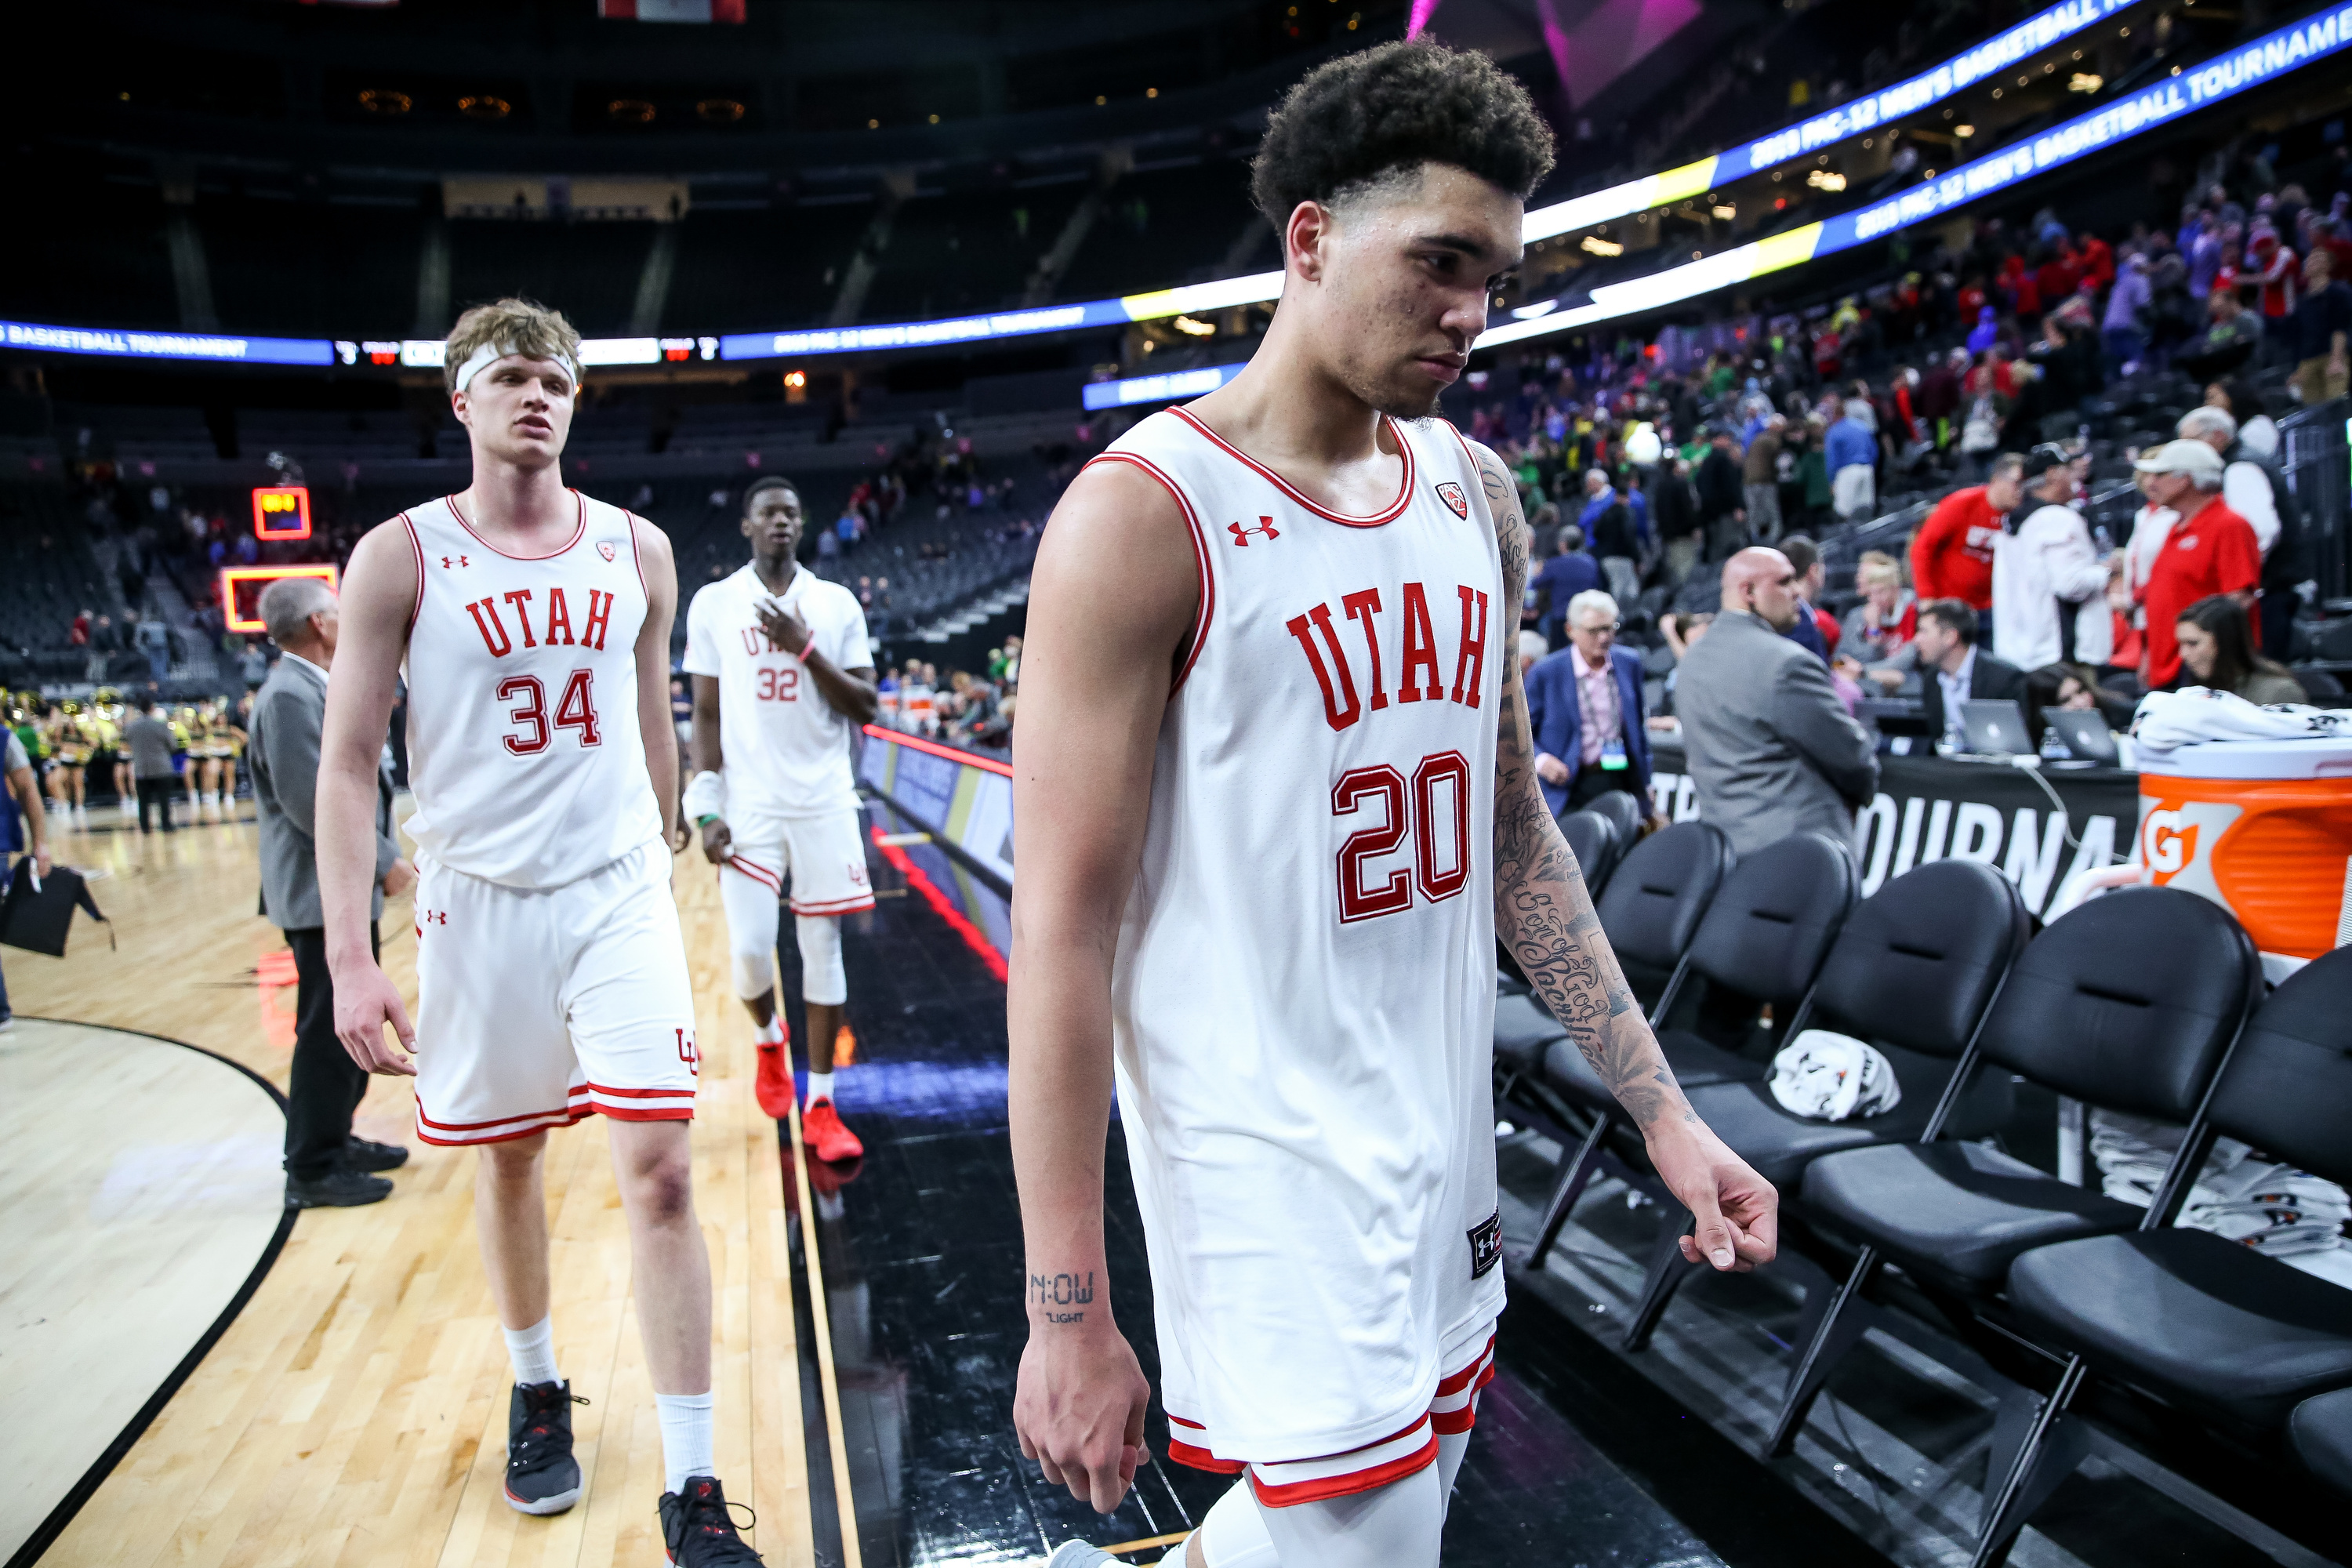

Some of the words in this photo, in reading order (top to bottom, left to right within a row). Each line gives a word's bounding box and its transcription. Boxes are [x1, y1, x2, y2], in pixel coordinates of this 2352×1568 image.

[1878, 66, 1953, 120] MEN'S
[1953, 0, 2100, 88] BASKETBALL
[1965, 146, 2034, 195] MEN'S
[2034, 83, 2187, 168] BASKETBALL
[8, 325, 129, 351] BASKETBALL
[127, 333, 248, 358] TOURNAMENT
[1437, 483, 1465, 506] PAC
[1449, 497, 1466, 513] 12
[466, 588, 614, 658] UTAH
[1286, 583, 1488, 732] UTAH
[496, 668, 602, 757] 34
[757, 668, 798, 701] 32
[1331, 750, 1471, 924] 20
[2144, 809, 2183, 873] G
[1563, 956, 1611, 1024] God
